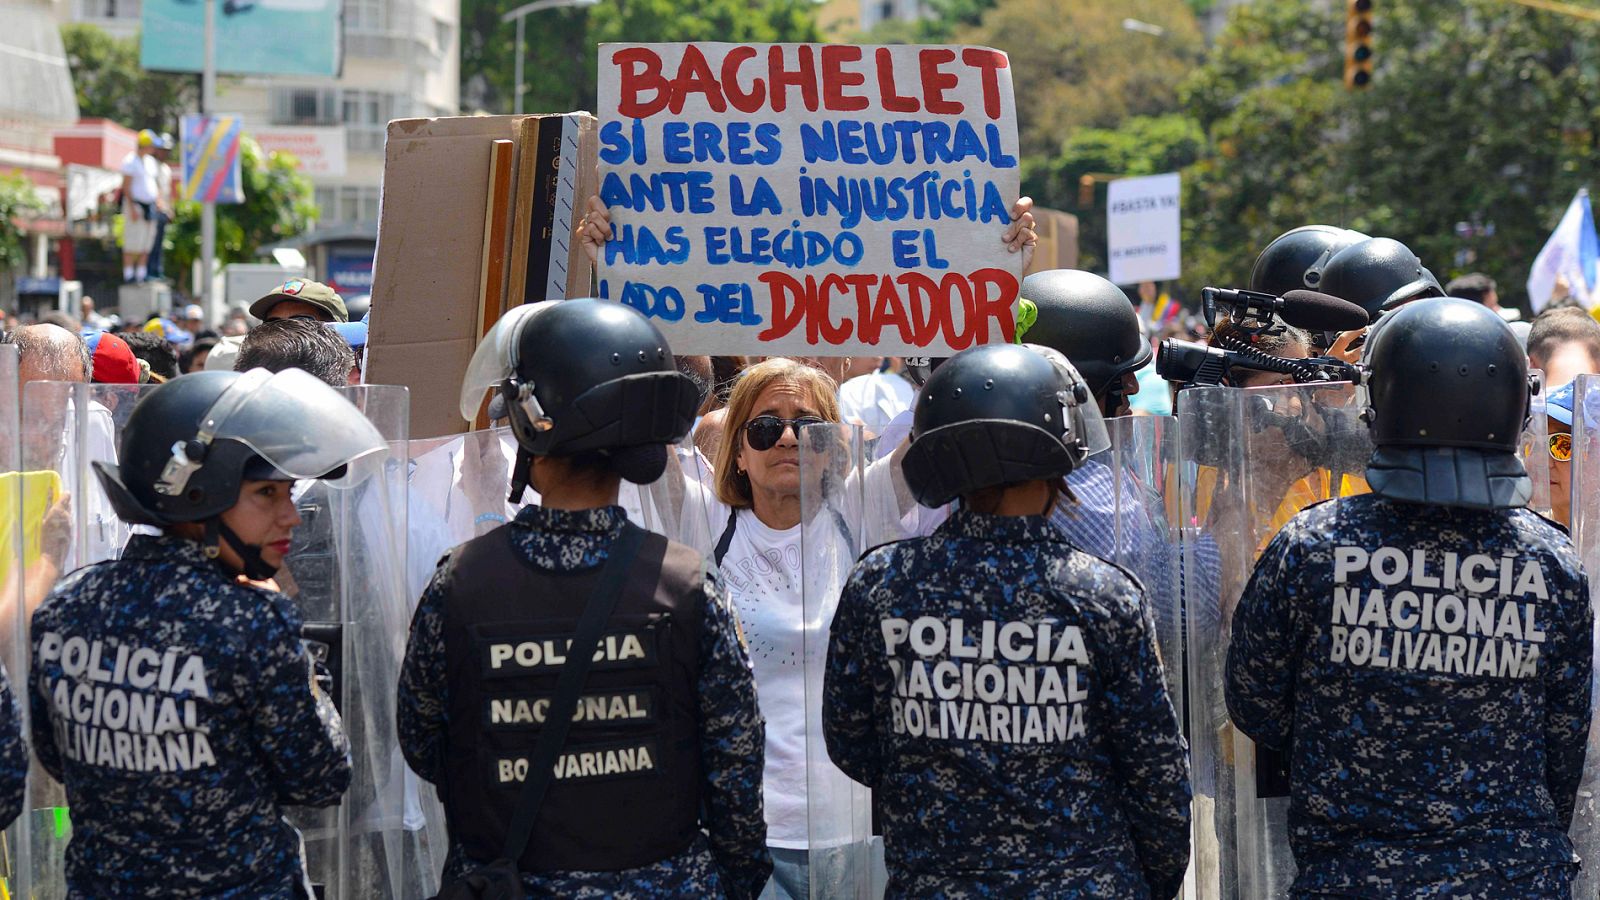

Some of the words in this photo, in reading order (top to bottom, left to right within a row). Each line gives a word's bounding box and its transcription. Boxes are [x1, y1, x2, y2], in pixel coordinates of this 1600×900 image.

[612, 44, 1008, 120] BACHELET
[663, 122, 781, 165] ERES
[800, 120, 1017, 168] NEUTRAL
[600, 171, 714, 214] ANTE
[729, 173, 782, 216] LA
[604, 223, 690, 265] HAS
[893, 229, 949, 269] EL
[695, 283, 762, 325] DEL
[757, 268, 1019, 351] DICTADOR
[1331, 586, 1546, 642] NACIONAL
[1330, 626, 1540, 678] BOLIVARIANA
[40, 676, 210, 734] ACIONAL
[891, 697, 1086, 744] BOLIVARIANA
[54, 717, 216, 772] LIVARIANA
[498, 747, 653, 782] BOVARIANA
